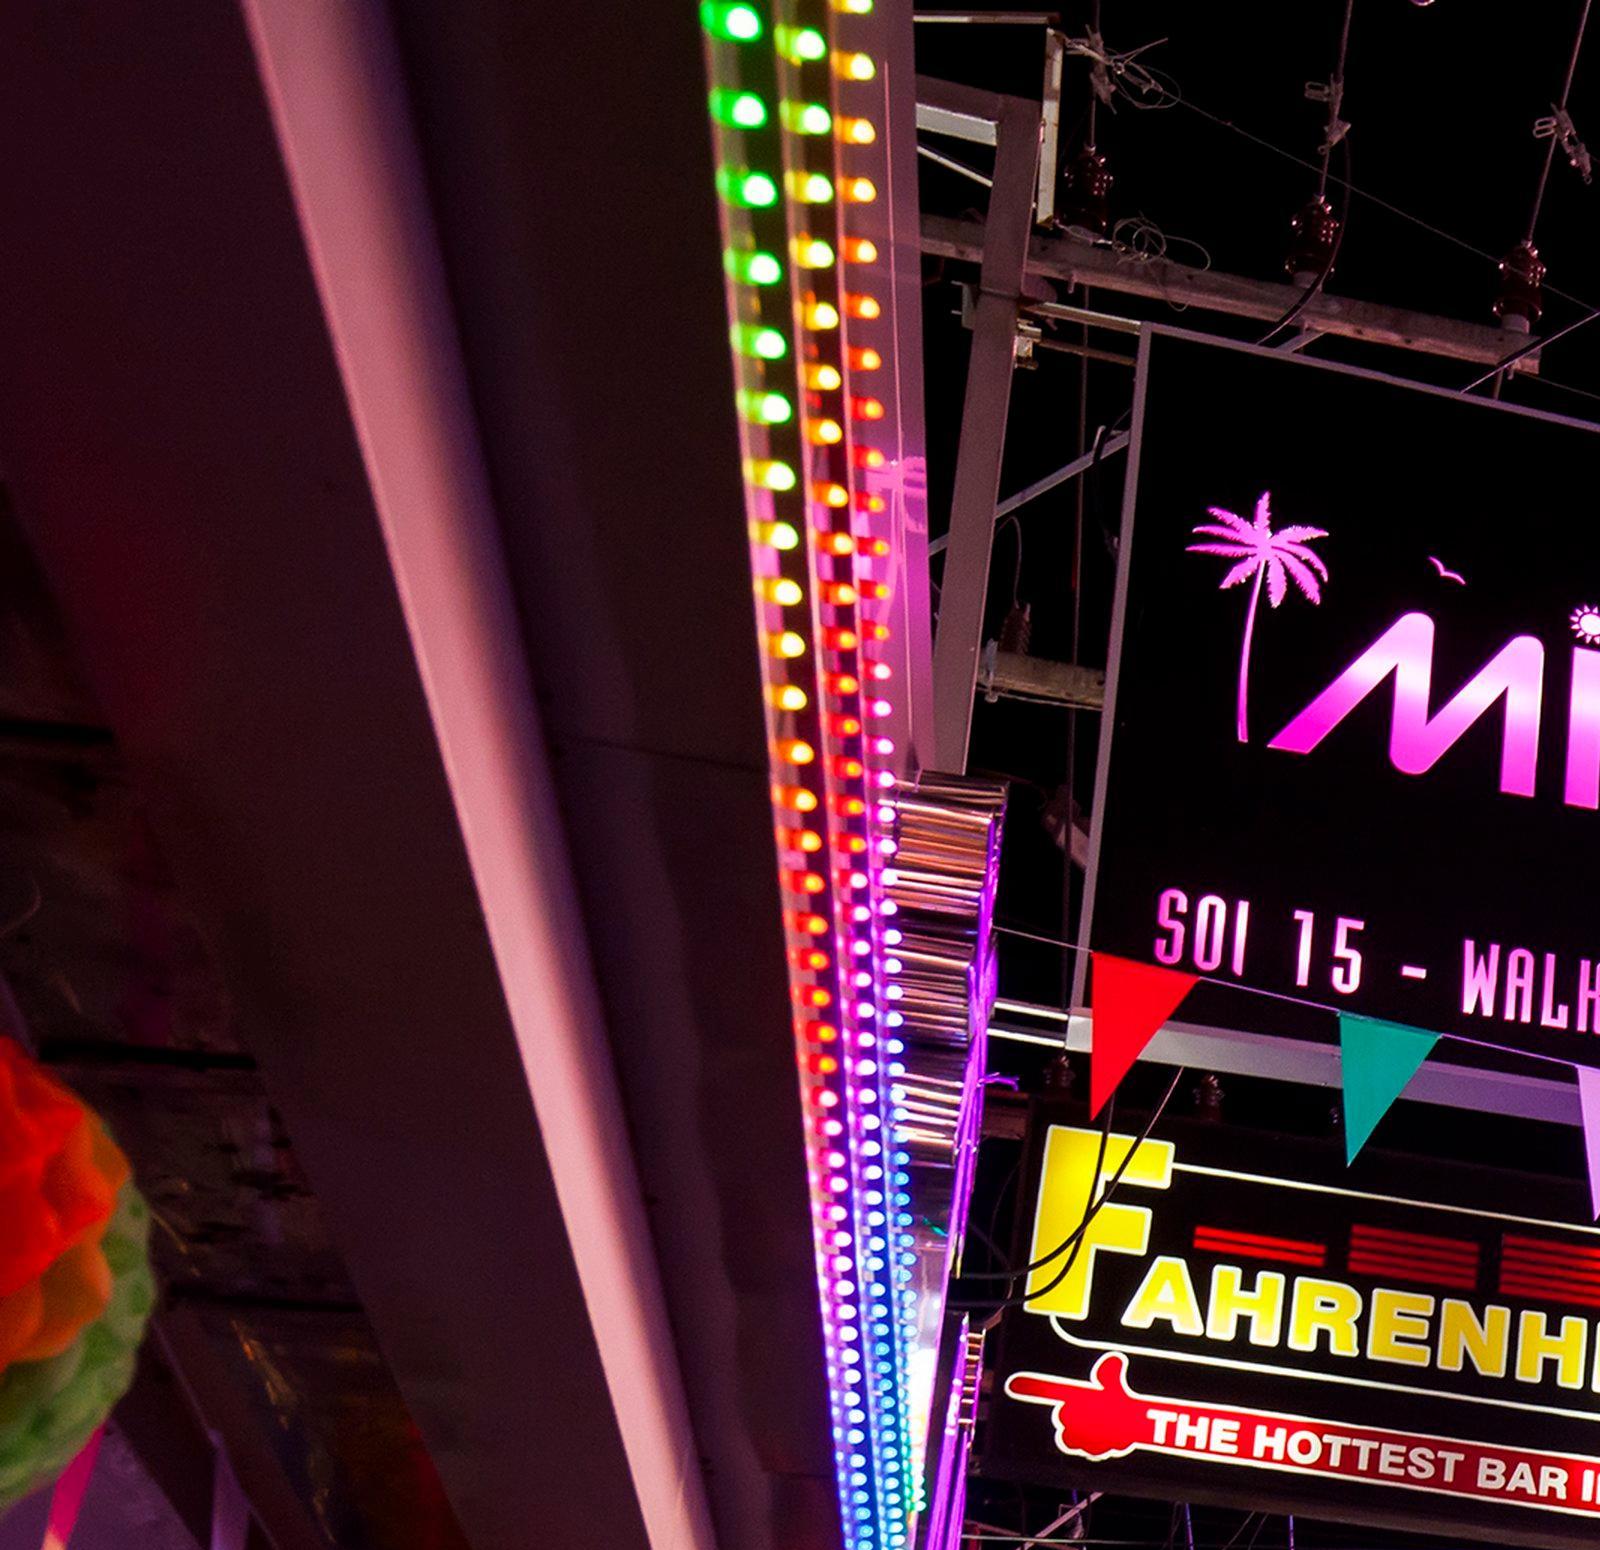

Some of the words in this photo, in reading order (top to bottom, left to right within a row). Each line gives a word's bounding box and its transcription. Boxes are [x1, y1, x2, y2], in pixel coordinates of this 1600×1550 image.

[1153, 887, 1247, 976] SOI
[1294, 909, 1365, 995] 15
[1147, 1408, 1239, 1453] THE
[1252, 1425, 1466, 1485] HOTTEST
[1475, 1454, 1568, 1500] BAR
